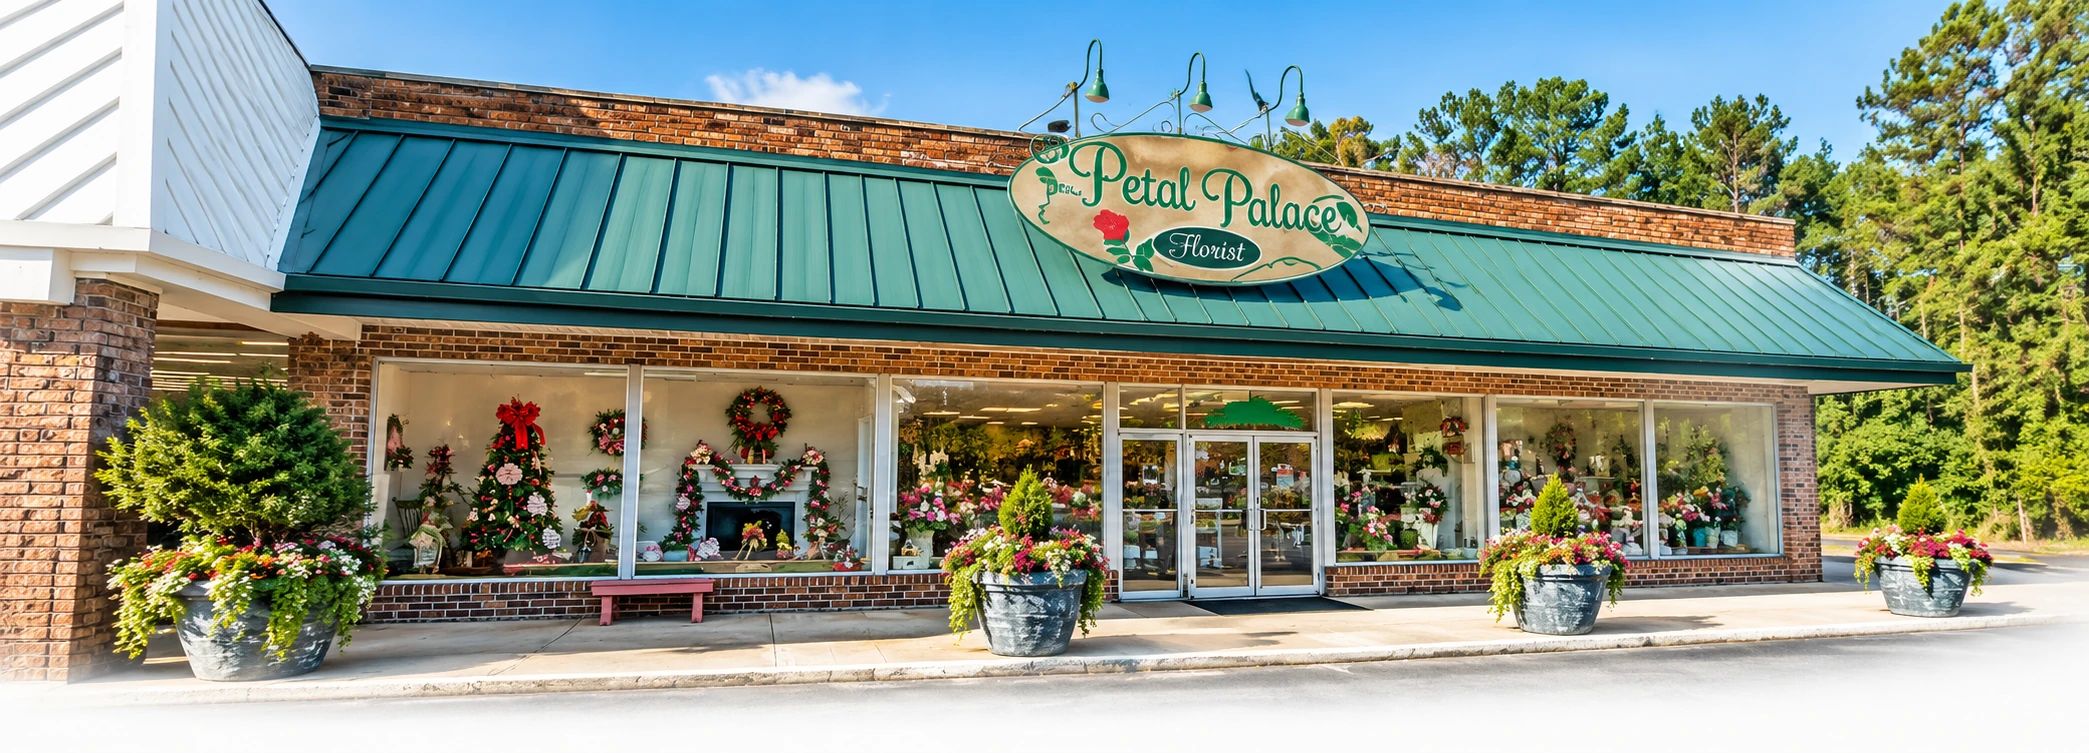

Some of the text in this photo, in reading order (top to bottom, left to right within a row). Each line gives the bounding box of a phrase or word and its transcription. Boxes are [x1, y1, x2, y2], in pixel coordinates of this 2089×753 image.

[1069, 141, 1342, 233] Petal Palace
[1168, 232, 1246, 262] Florist
